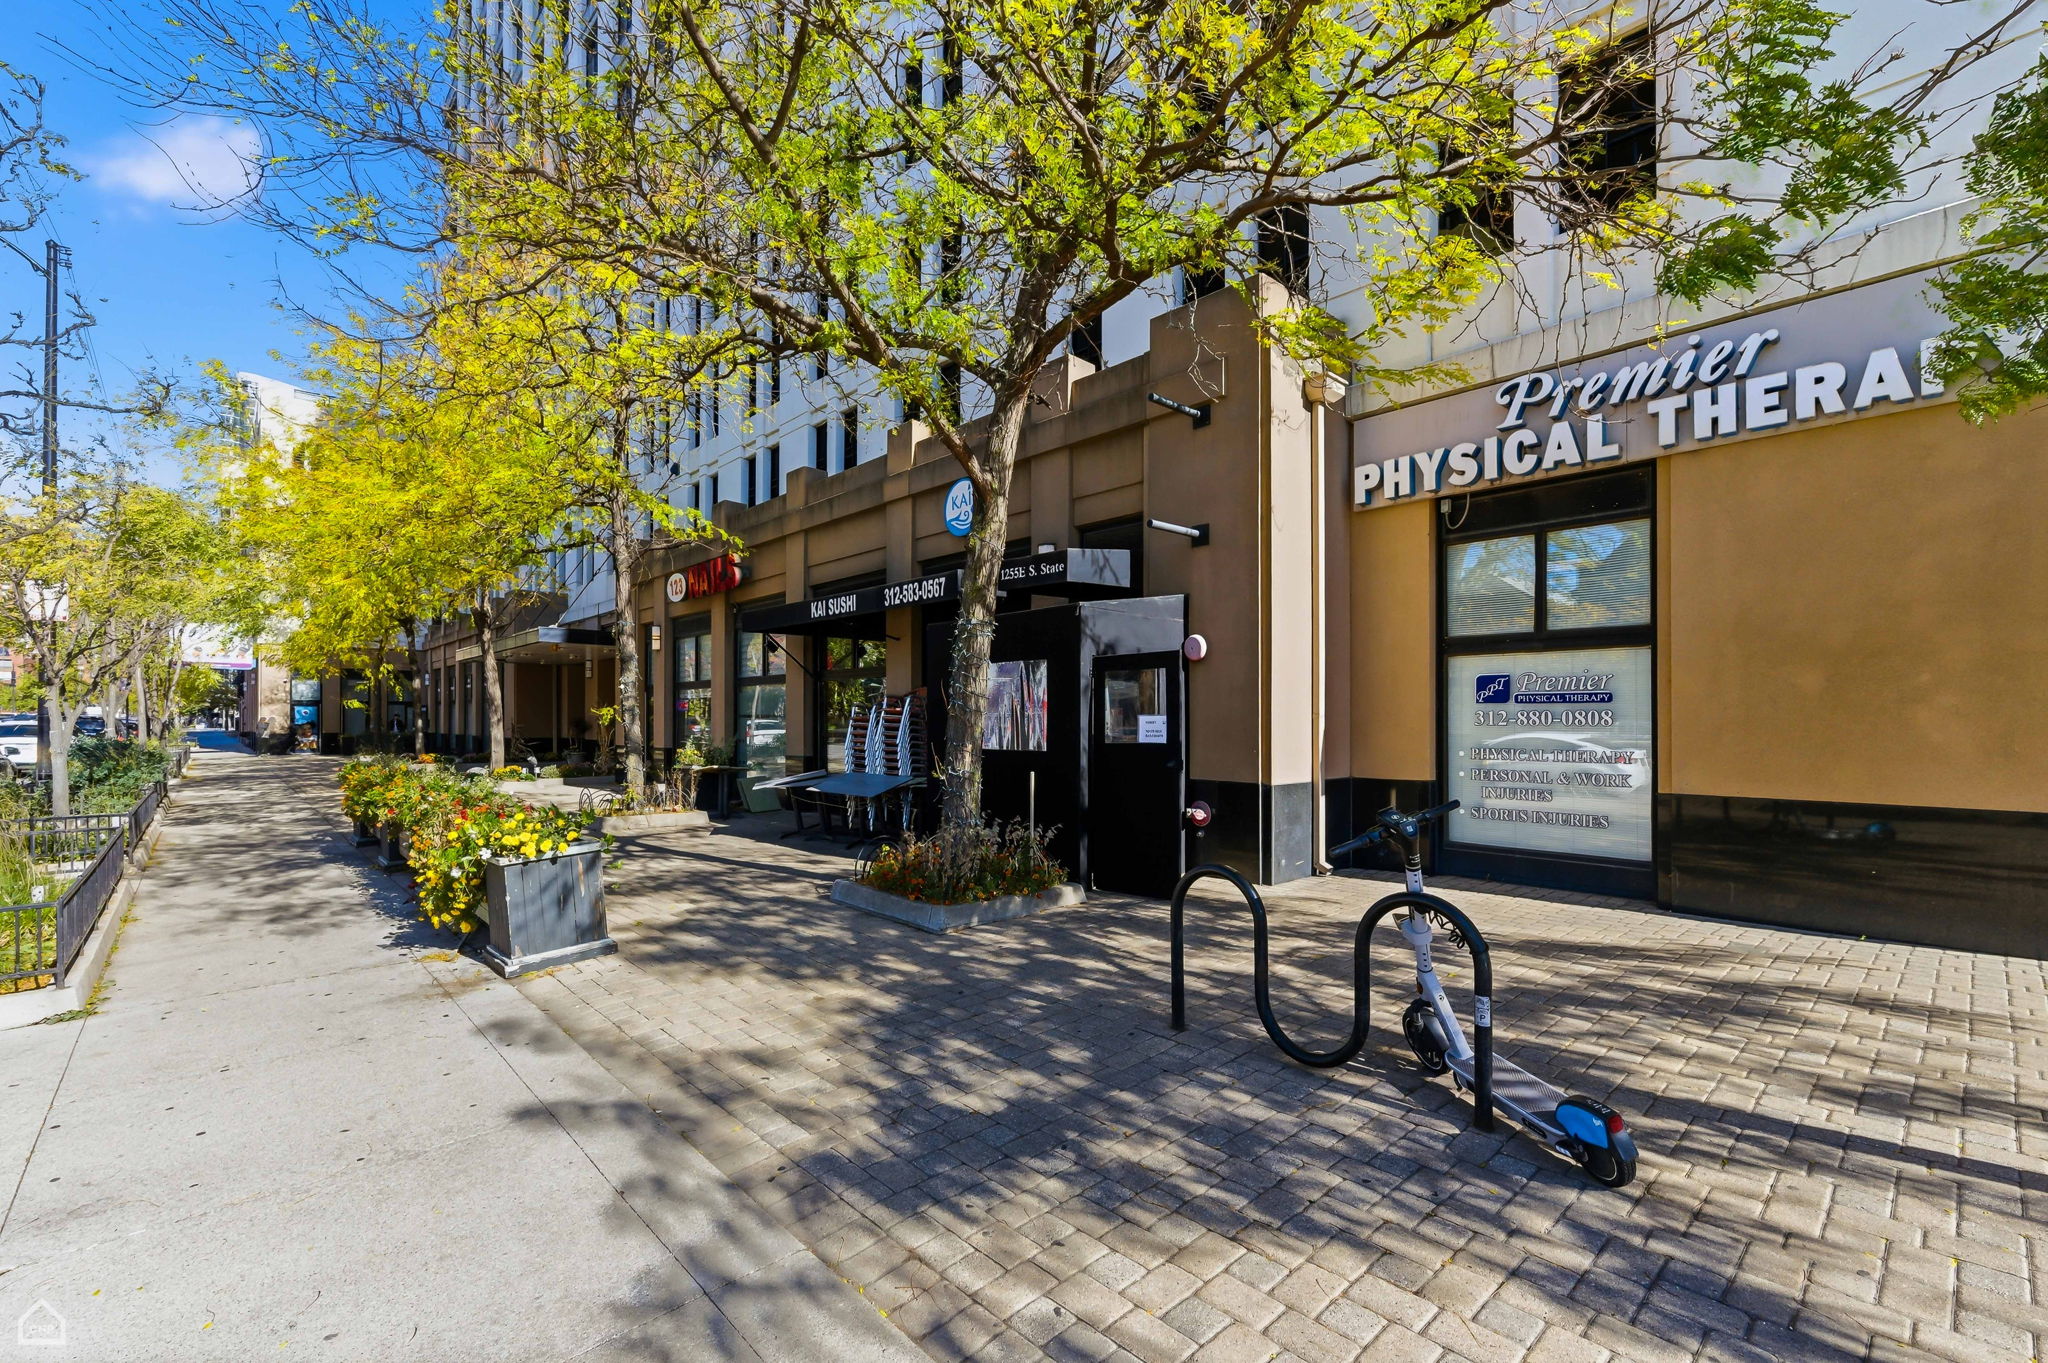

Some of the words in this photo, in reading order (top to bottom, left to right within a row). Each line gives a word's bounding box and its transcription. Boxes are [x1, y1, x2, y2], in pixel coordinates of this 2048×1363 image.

[1496, 329, 1780, 431] Premier
[1354, 413, 1622, 506] PHYSICAL
[951, 484, 972, 511] KAI
[669, 578, 683, 597] 123
[687, 553, 742, 600] NAILS
[1001, 566, 1026, 581] 1255E
[1029, 564, 1037, 577] S.
[1040, 562, 1065, 575] State
[811, 600, 826, 619] KAI
[828, 594, 856, 616] SUSHI
[884, 577, 946, 607] 312-583-0567
[1476, 677, 1509, 703] PPT
[1516, 669, 1615, 692] Premier
[1517, 694, 1563, 703] PHYSICAL
[1565, 693, 1610, 703] THERAPY
[1474, 709, 1614, 727] 312-880-0808
[1471, 748, 1550, 763] PHYSICAL
[1552, 750, 1635, 765] THERAPY
[1471, 768, 1553, 785] PERSONAL
[1557, 771, 1571, 785] &
[1575, 771, 1633, 789] WORK
[1481, 786, 1553, 803] INJURIES
[1471, 807, 1529, 823] SPORTS
[1531, 811, 1610, 830] INJURIES
